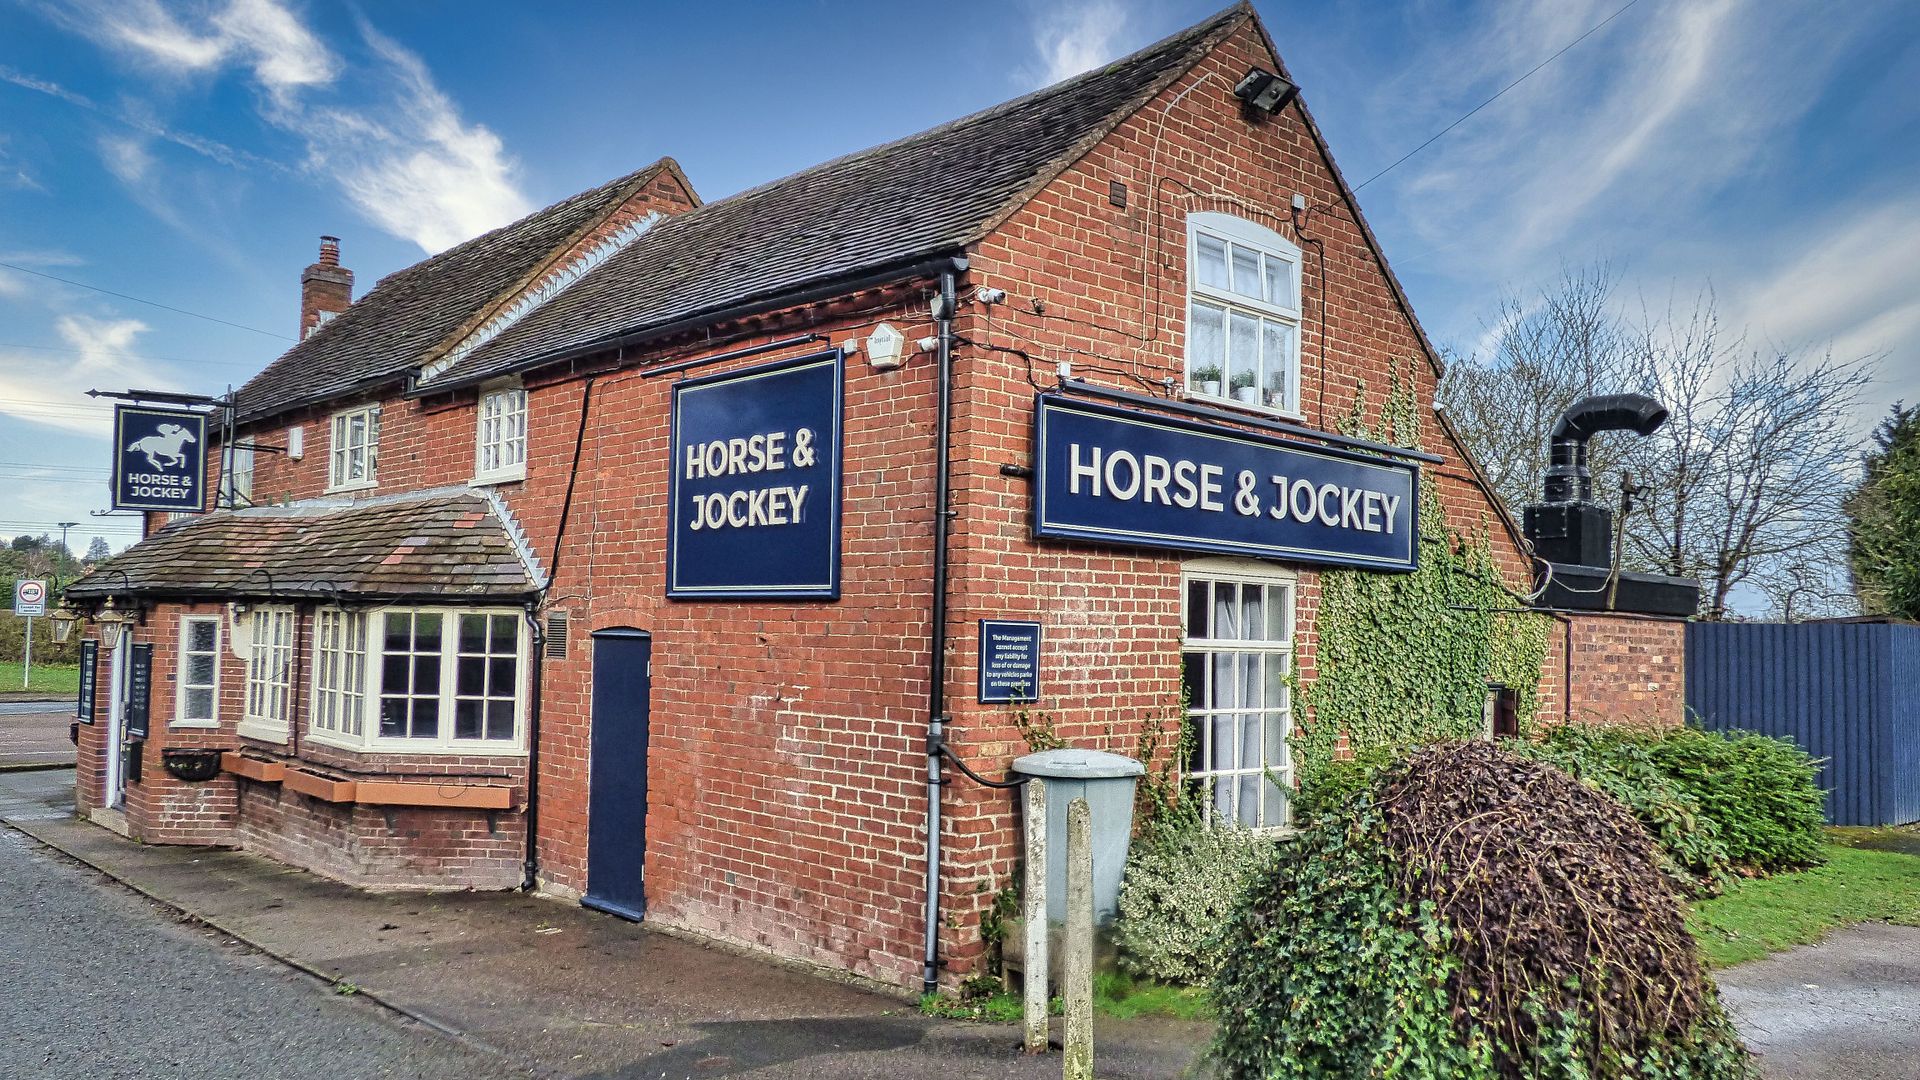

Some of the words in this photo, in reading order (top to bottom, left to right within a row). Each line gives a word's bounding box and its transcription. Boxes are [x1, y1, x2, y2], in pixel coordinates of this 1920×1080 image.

[686, 431, 786, 480] HORSE
[792, 428, 815, 467] &
[128, 473, 180, 486] HORSE
[181, 475, 193, 487] &
[130, 486, 190, 499] JOCKEY
[1069, 443, 1224, 513] HORSE
[1234, 469, 1261, 518] &
[1269, 474, 1401, 534] JOCKEY
[690, 484, 809, 531] JOCKEY
[1002, 634, 1032, 642] Management
[991, 661, 1001, 669] loss
[1001, 661, 1007, 669] of
[1012, 662, 1031, 670] damage
